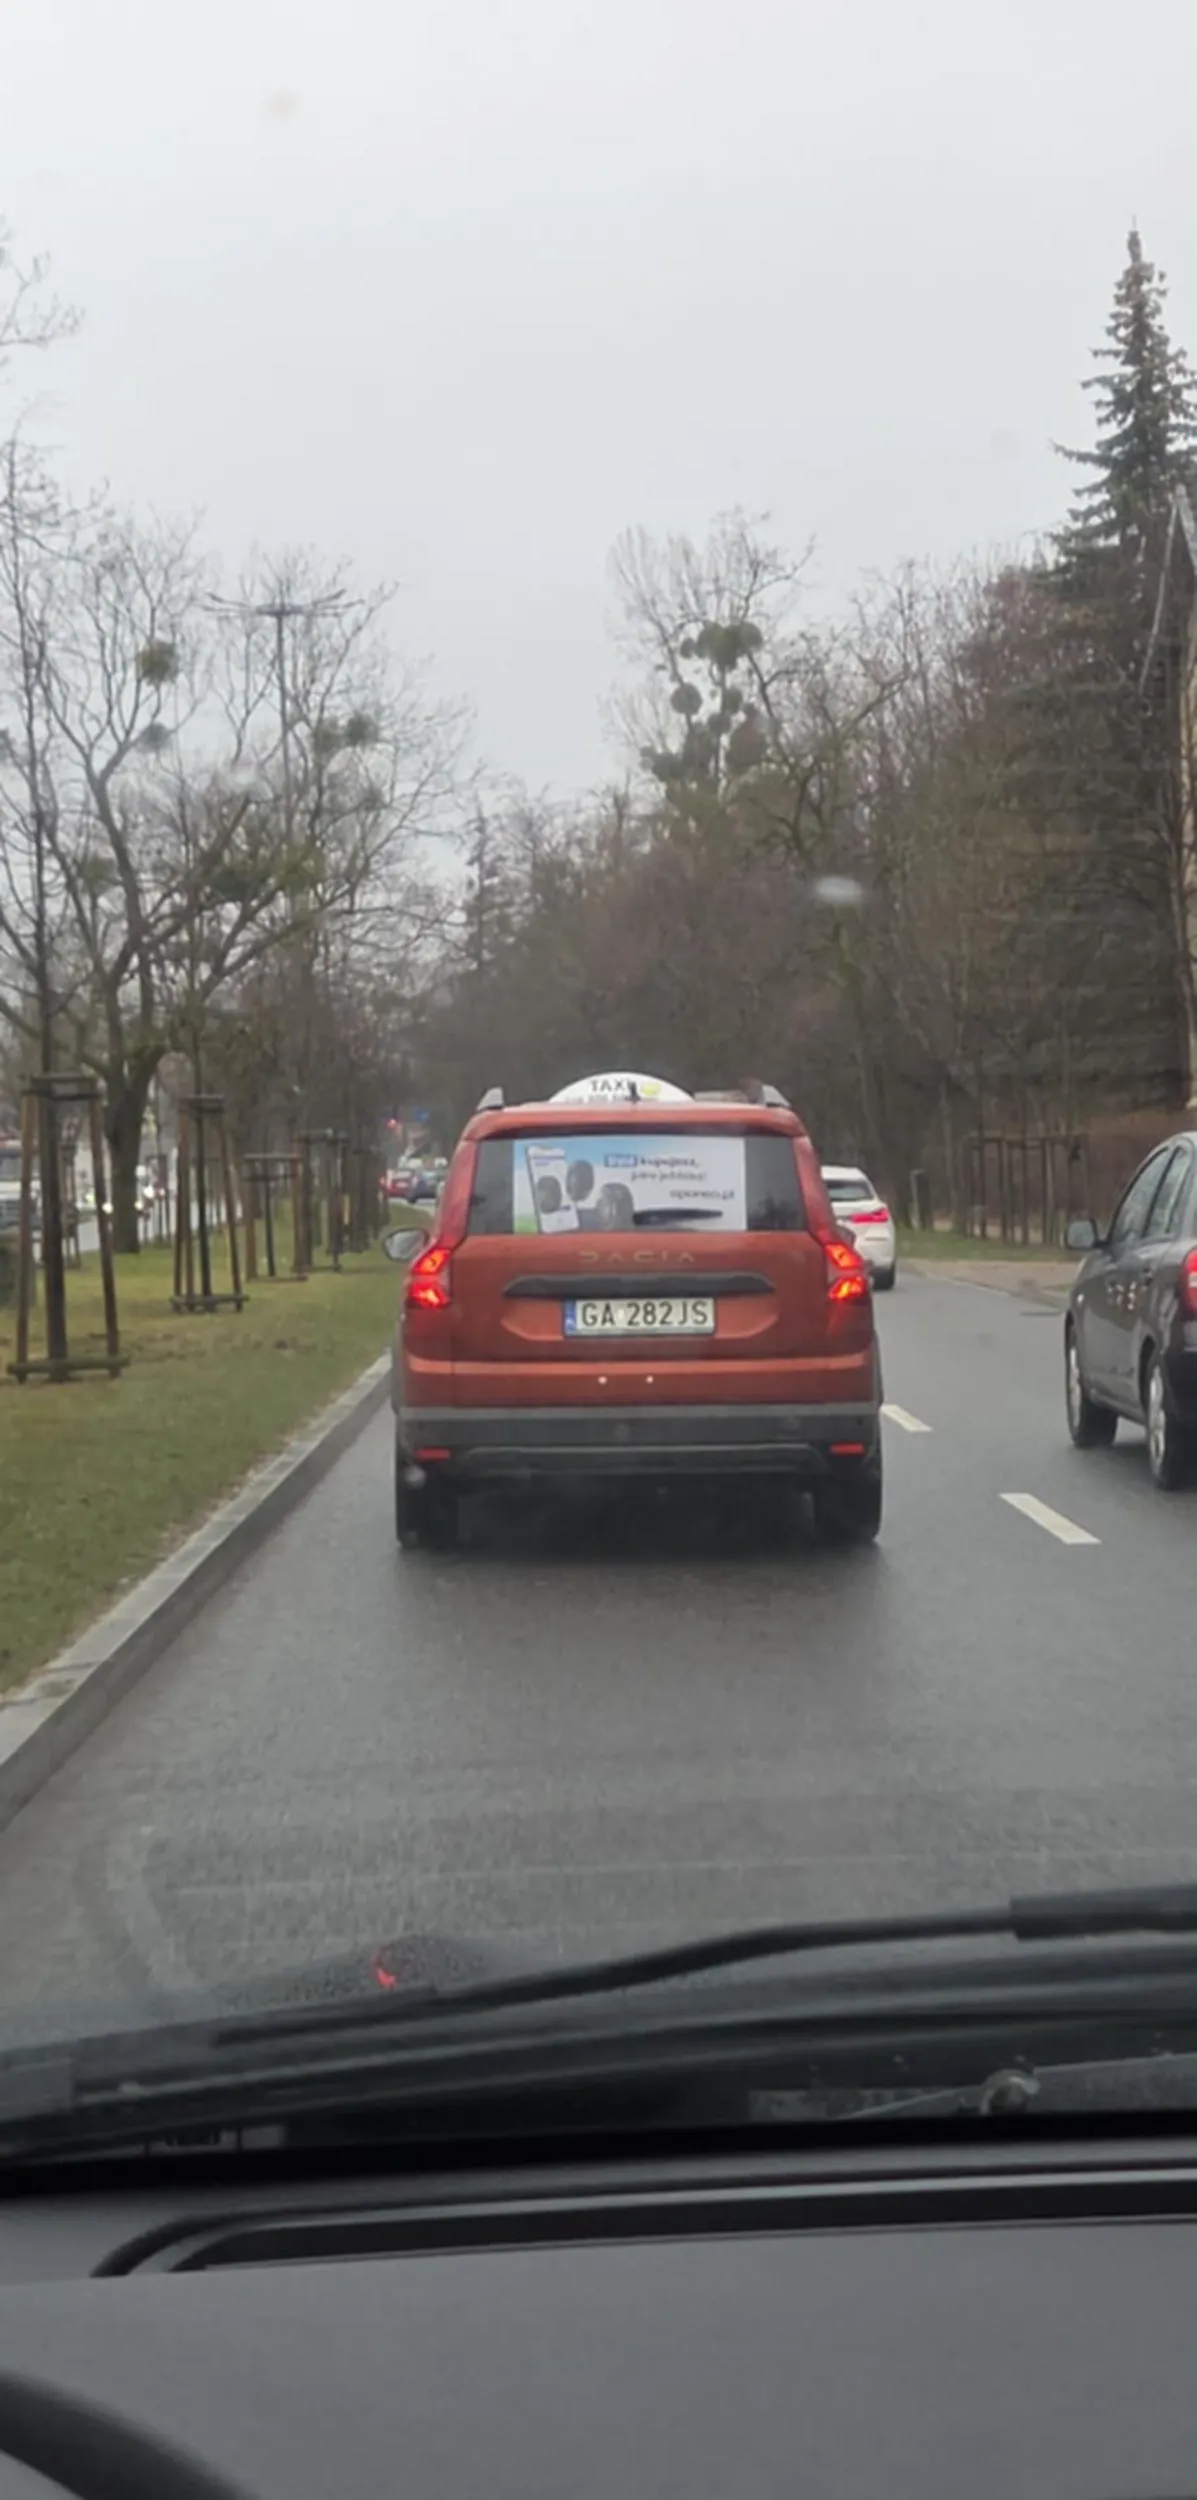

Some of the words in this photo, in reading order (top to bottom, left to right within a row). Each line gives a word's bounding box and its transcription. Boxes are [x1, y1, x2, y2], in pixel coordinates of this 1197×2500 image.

[577, 1250, 695, 1263] DACIA
[581, 1302, 615, 1327] GA
[627, 1301, 708, 1326] 282JS
